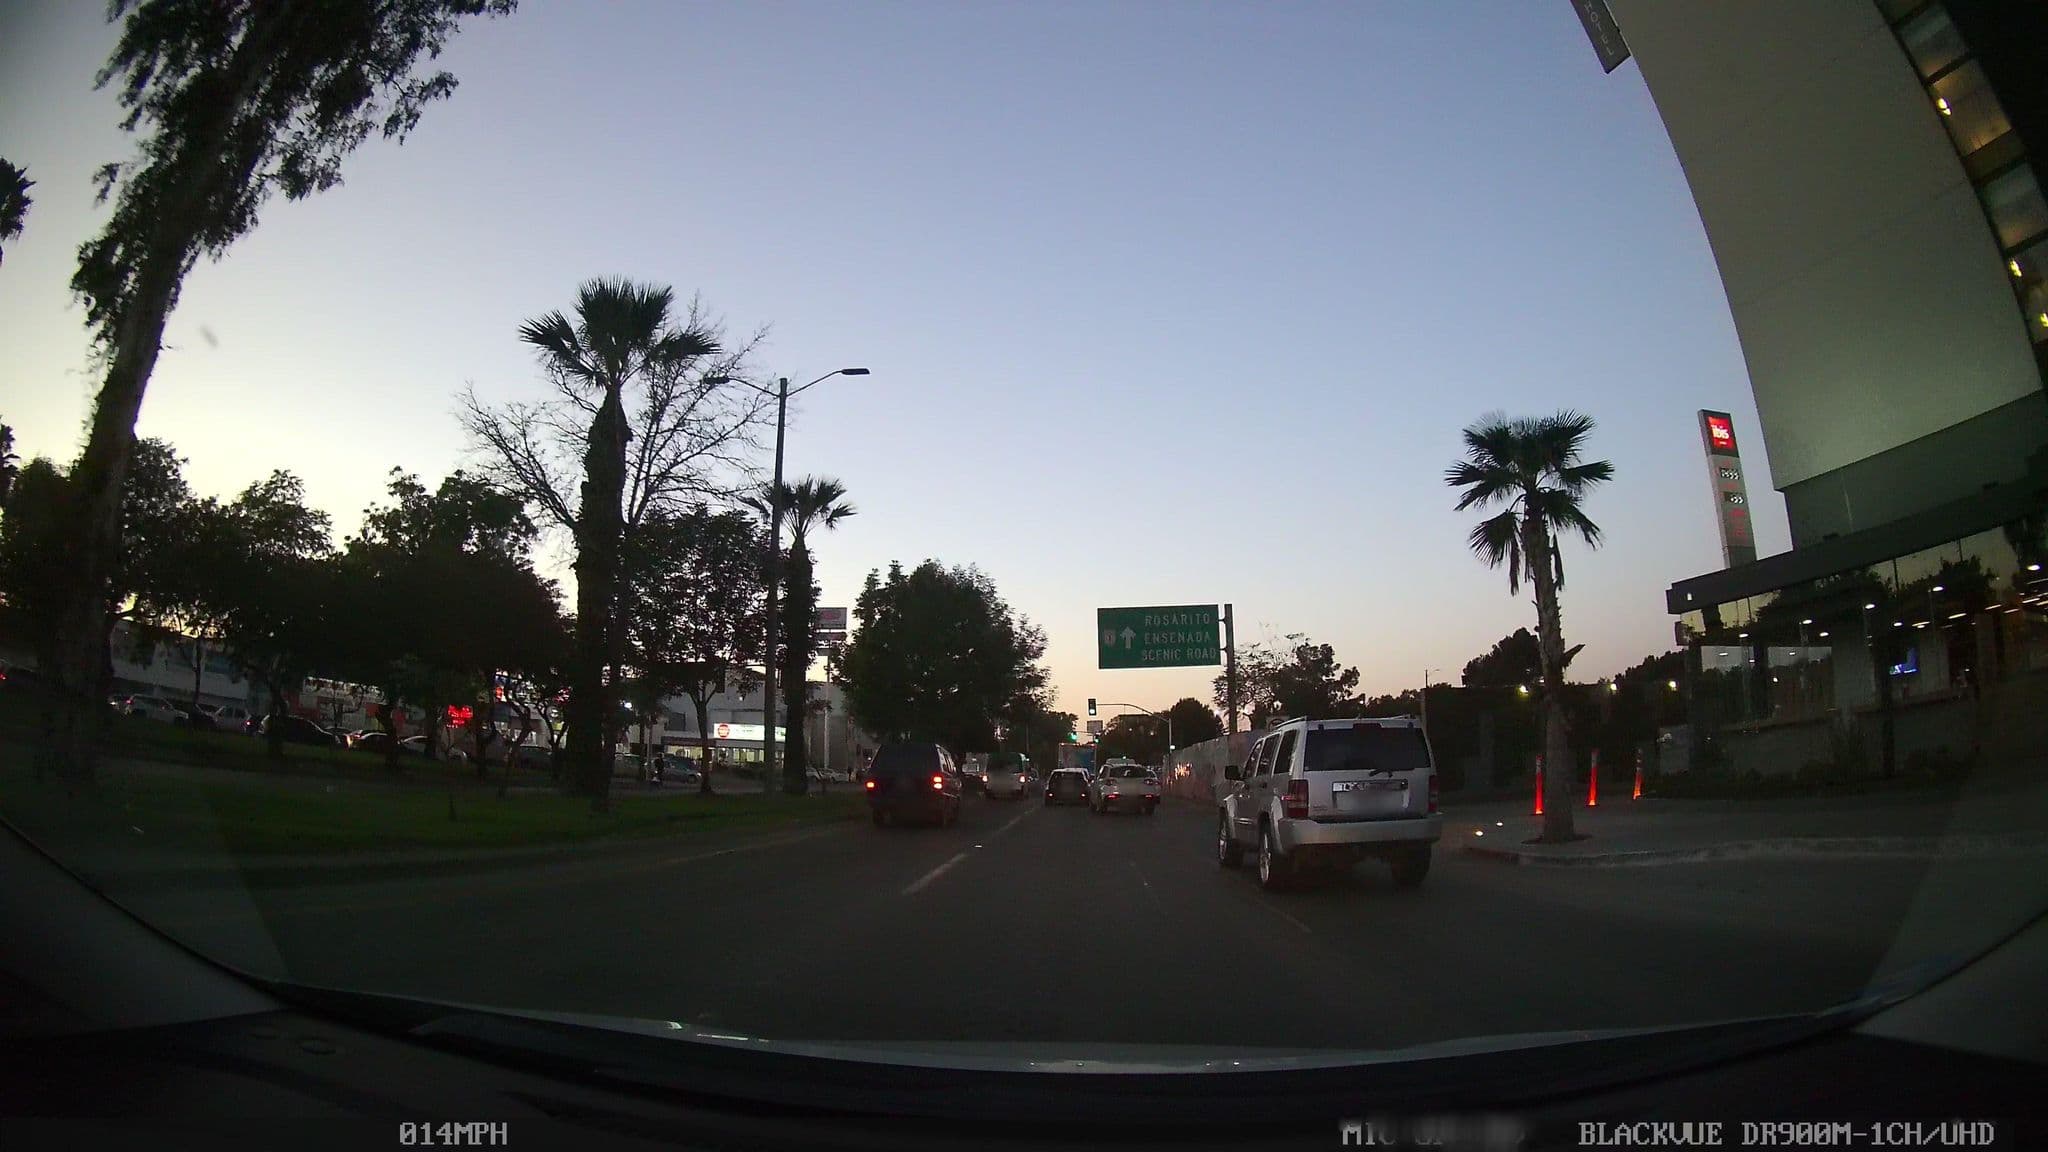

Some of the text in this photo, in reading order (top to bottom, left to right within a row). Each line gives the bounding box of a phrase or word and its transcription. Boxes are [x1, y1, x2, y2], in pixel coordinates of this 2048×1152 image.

[1144, 613, 1211, 627] ROSARITO
[1144, 631, 1212, 645] ENSENADA
[1142, 647, 1217, 661] SCENIC ROAD
